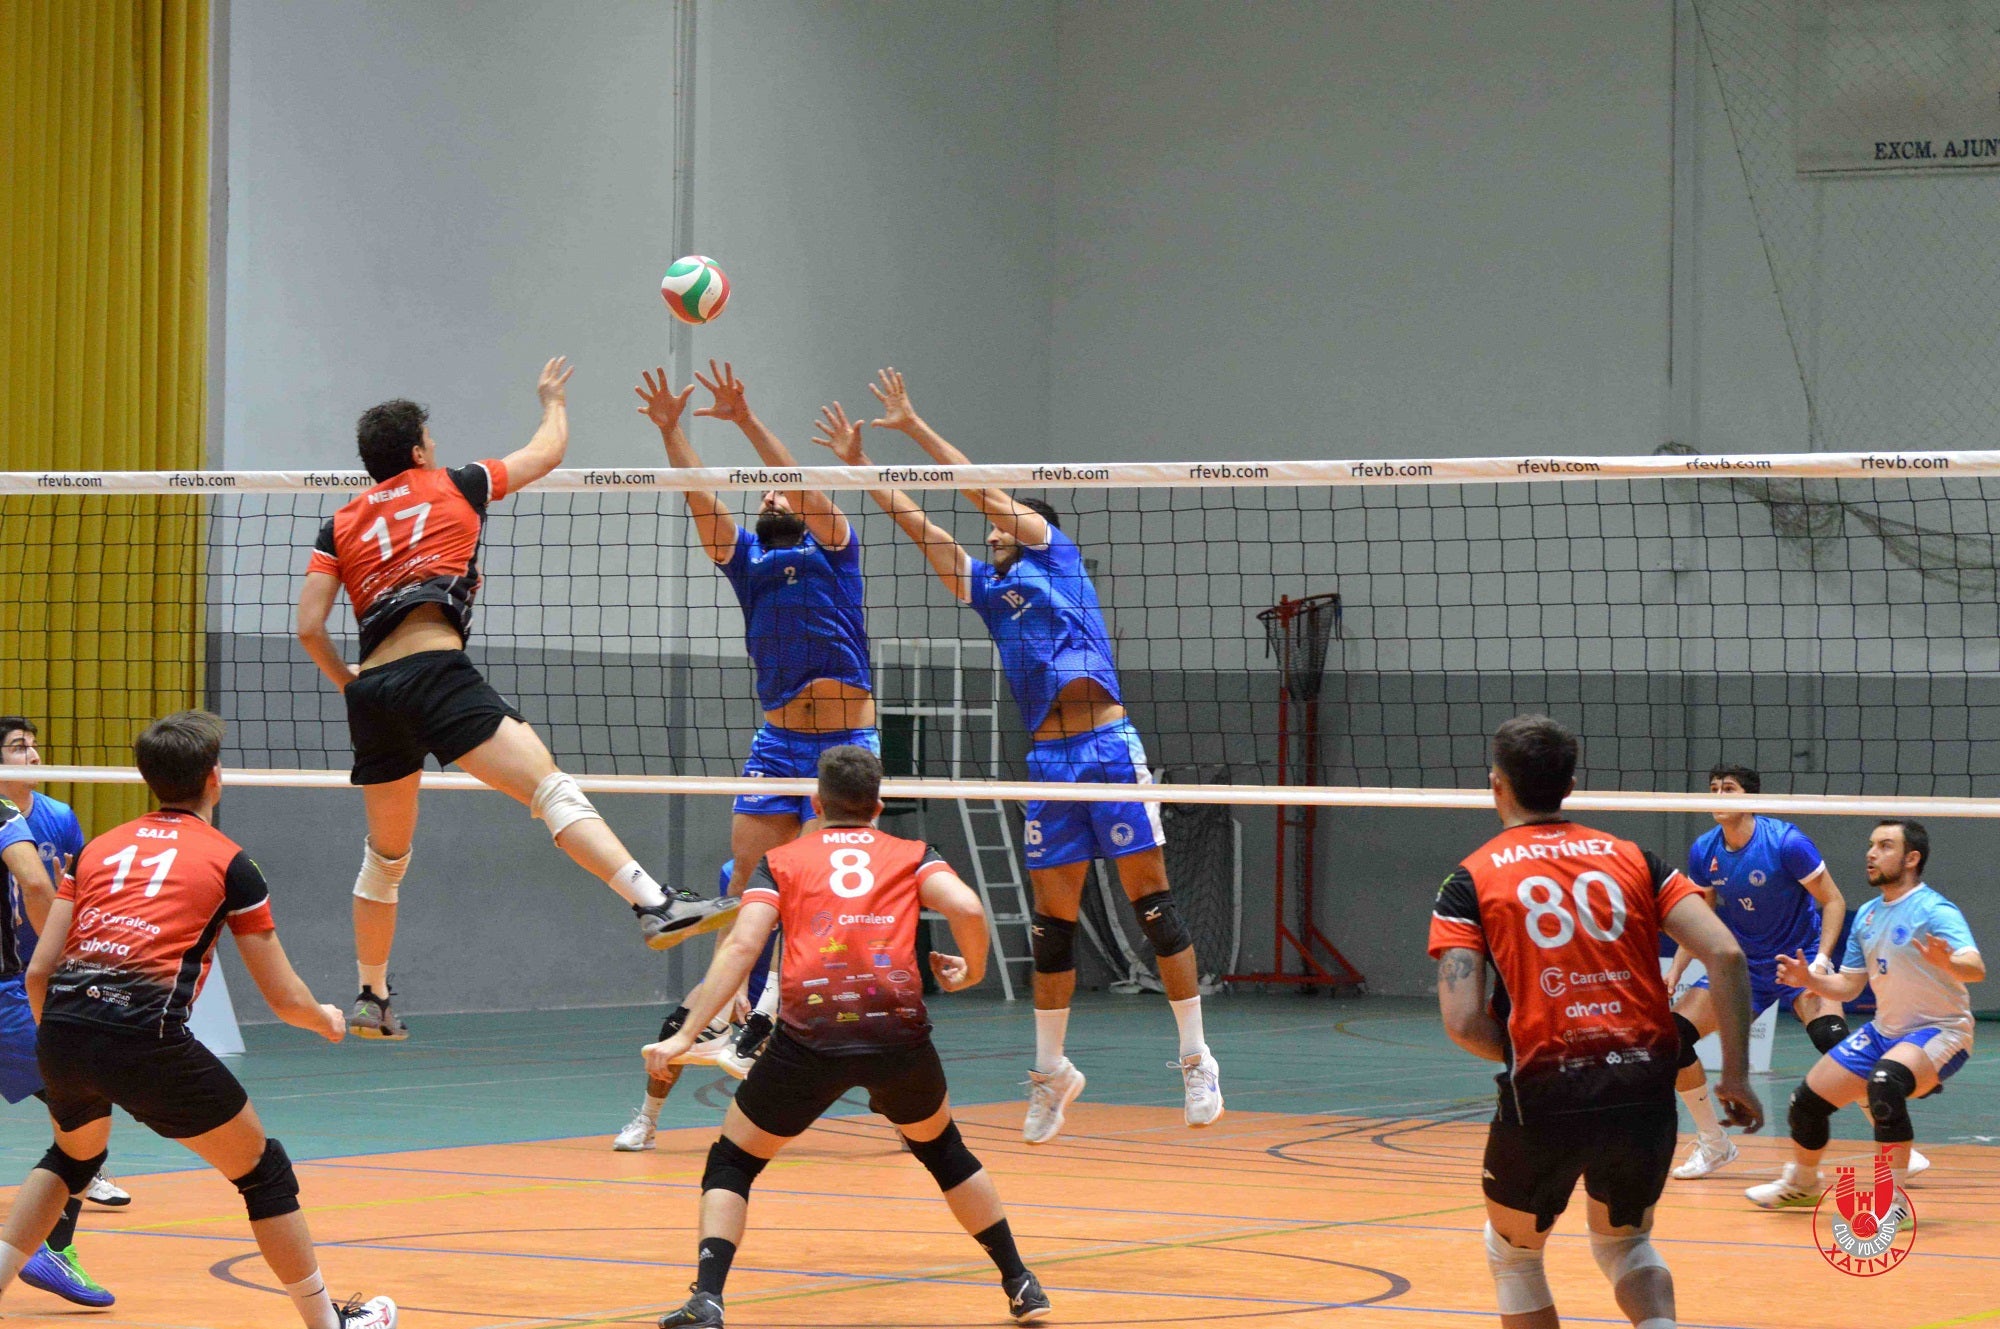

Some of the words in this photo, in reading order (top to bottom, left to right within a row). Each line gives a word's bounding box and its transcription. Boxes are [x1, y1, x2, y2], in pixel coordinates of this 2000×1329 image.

[1873, 141, 1938, 161] EXCM.
[1942, 138, 2000, 159] AJUN
[37, 474, 102, 488] rfevb.com
[168, 473, 236, 487] rfevb.com
[303, 473, 373, 487] rfevb.com
[583, 471, 656, 485] rfevb.com
[729, 469, 803, 484] rfevb.com
[878, 468, 954, 483] rfevb.com
[1031, 466, 1109, 481] rfevb.com
[1189, 464, 1269, 479] rfevb.com
[1351, 462, 1433, 478] rfevb.com
[1516, 459, 1601, 474] rfevb.com
[1685, 458, 1773, 471] rfevb.com
[1861, 455, 1949, 470] rfevb.com
[367, 484, 411, 505] NEME
[361, 501, 433, 562] 17
[784, 566, 799, 585] 2
[1001, 590, 1025, 609] 16
[135, 827, 179, 840] SALA
[822, 830, 875, 845] MICÓ
[1490, 838, 1618, 868] MARTÍNEZ
[103, 844, 178, 898] 11
[828, 848, 875, 899] 8
[1516, 870, 1628, 949] 80
[1738, 897, 1756, 911] 12
[101, 912, 161, 935] Carralero
[838, 912, 896, 927] Carralero
[79, 937, 131, 957] ahora
[1569, 968, 1632, 985] Carralero
[1565, 1000, 1622, 1018] ahora
[1845, 1027, 1872, 1051] 13
